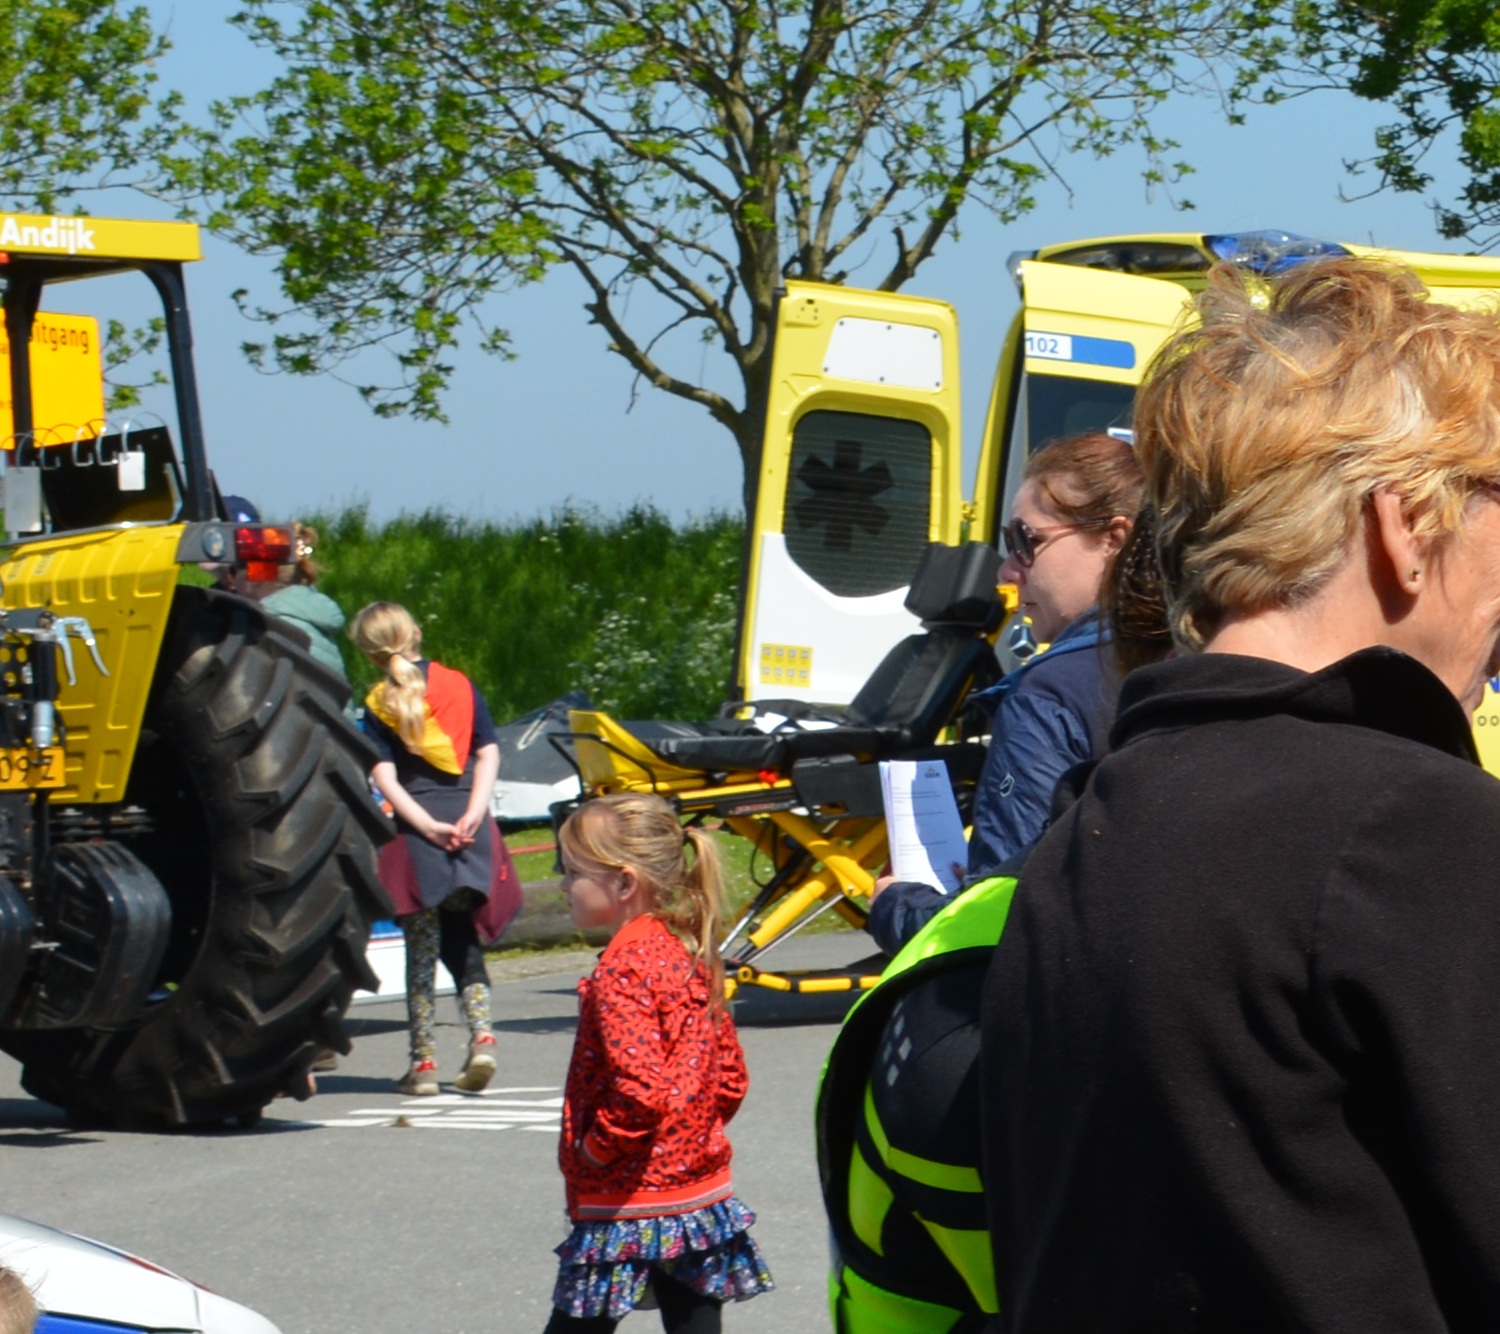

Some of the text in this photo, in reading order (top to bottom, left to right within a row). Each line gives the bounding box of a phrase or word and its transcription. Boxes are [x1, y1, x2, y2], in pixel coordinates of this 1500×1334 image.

[0, 217, 96, 255] Andijk
[29, 317, 90, 354] itgang
[1027, 336, 1059, 355] 102
